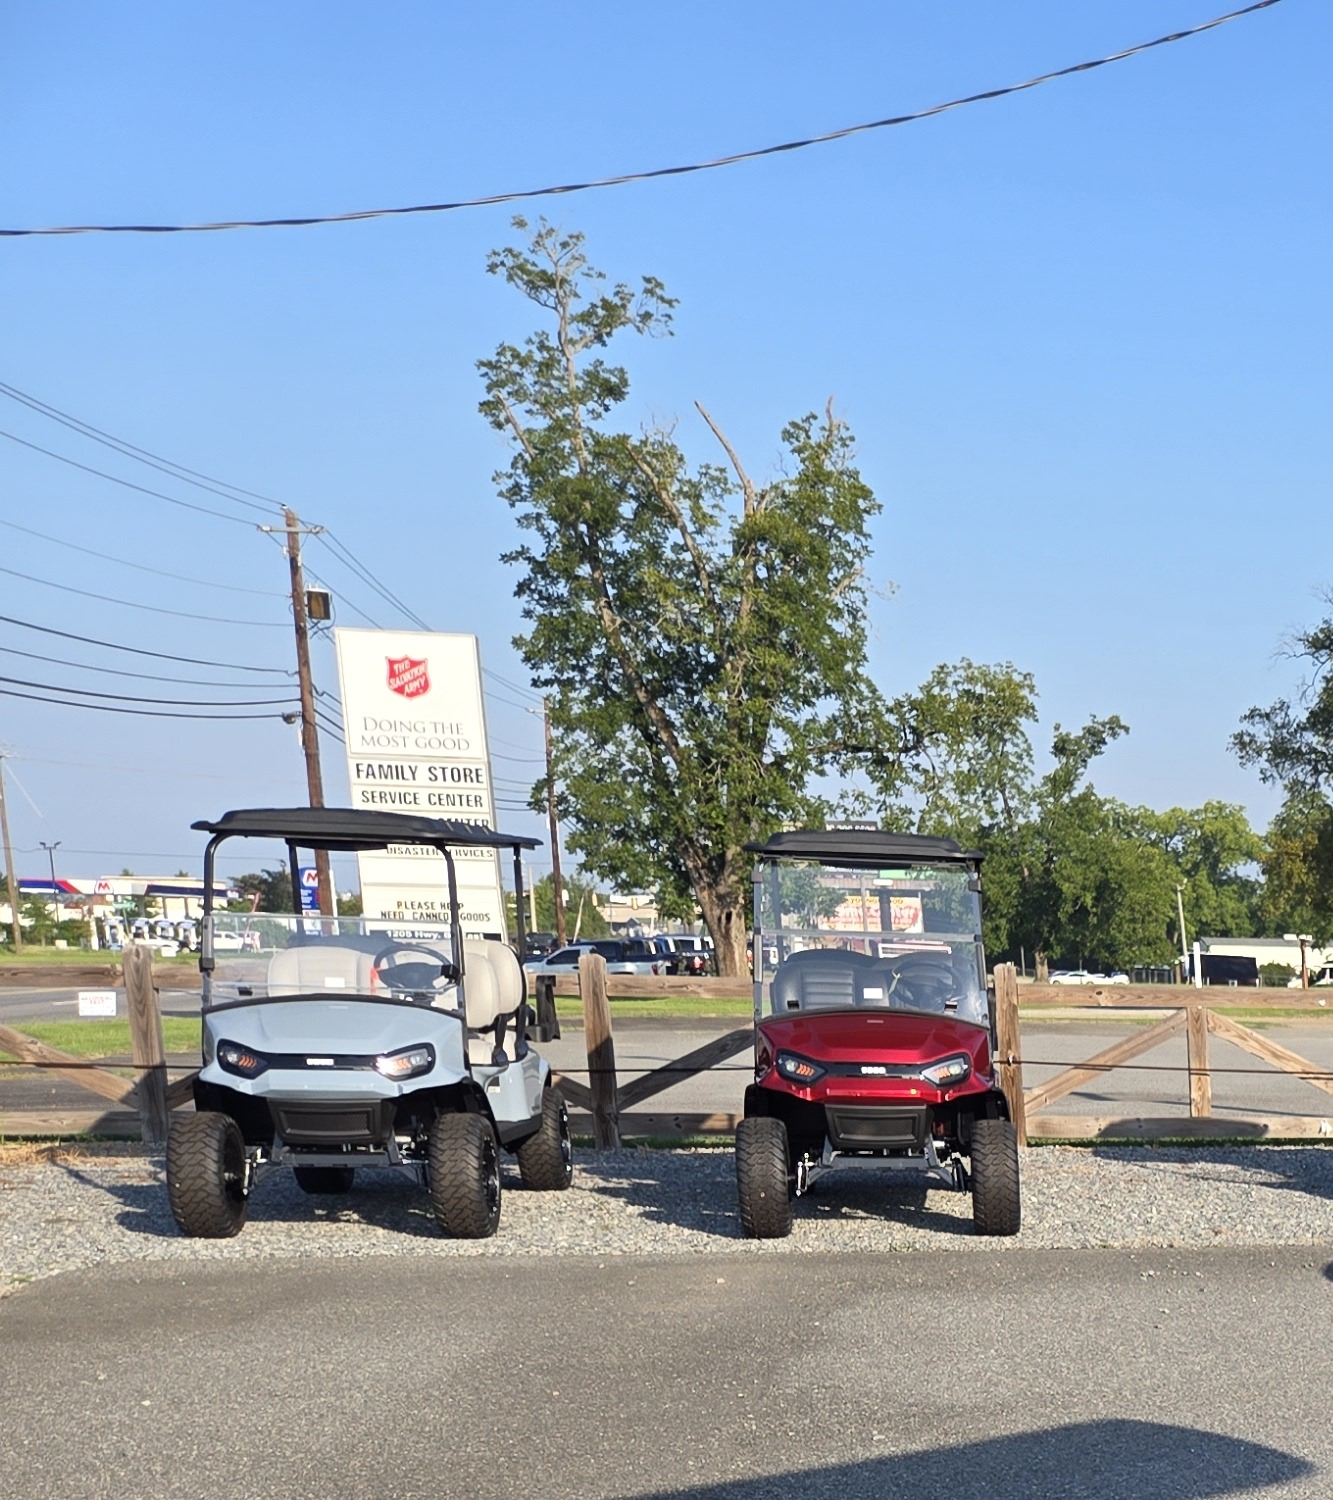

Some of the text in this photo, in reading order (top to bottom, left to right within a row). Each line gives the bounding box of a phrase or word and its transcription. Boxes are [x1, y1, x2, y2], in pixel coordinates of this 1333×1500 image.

[389, 662, 426, 689] SALVATION
[393, 660, 411, 676] THE
[404, 674, 426, 697] ARMY
[363, 716, 464, 736] DOING THE
[361, 735, 470, 751] MOST GOOD
[355, 763, 484, 784] FAMILY STORE
[361, 790, 483, 808] SERVICE CENTER
[397, 900, 436, 911] PLEASE
[381, 911, 405, 921] NEED
[459, 913, 491, 922] GOODS
